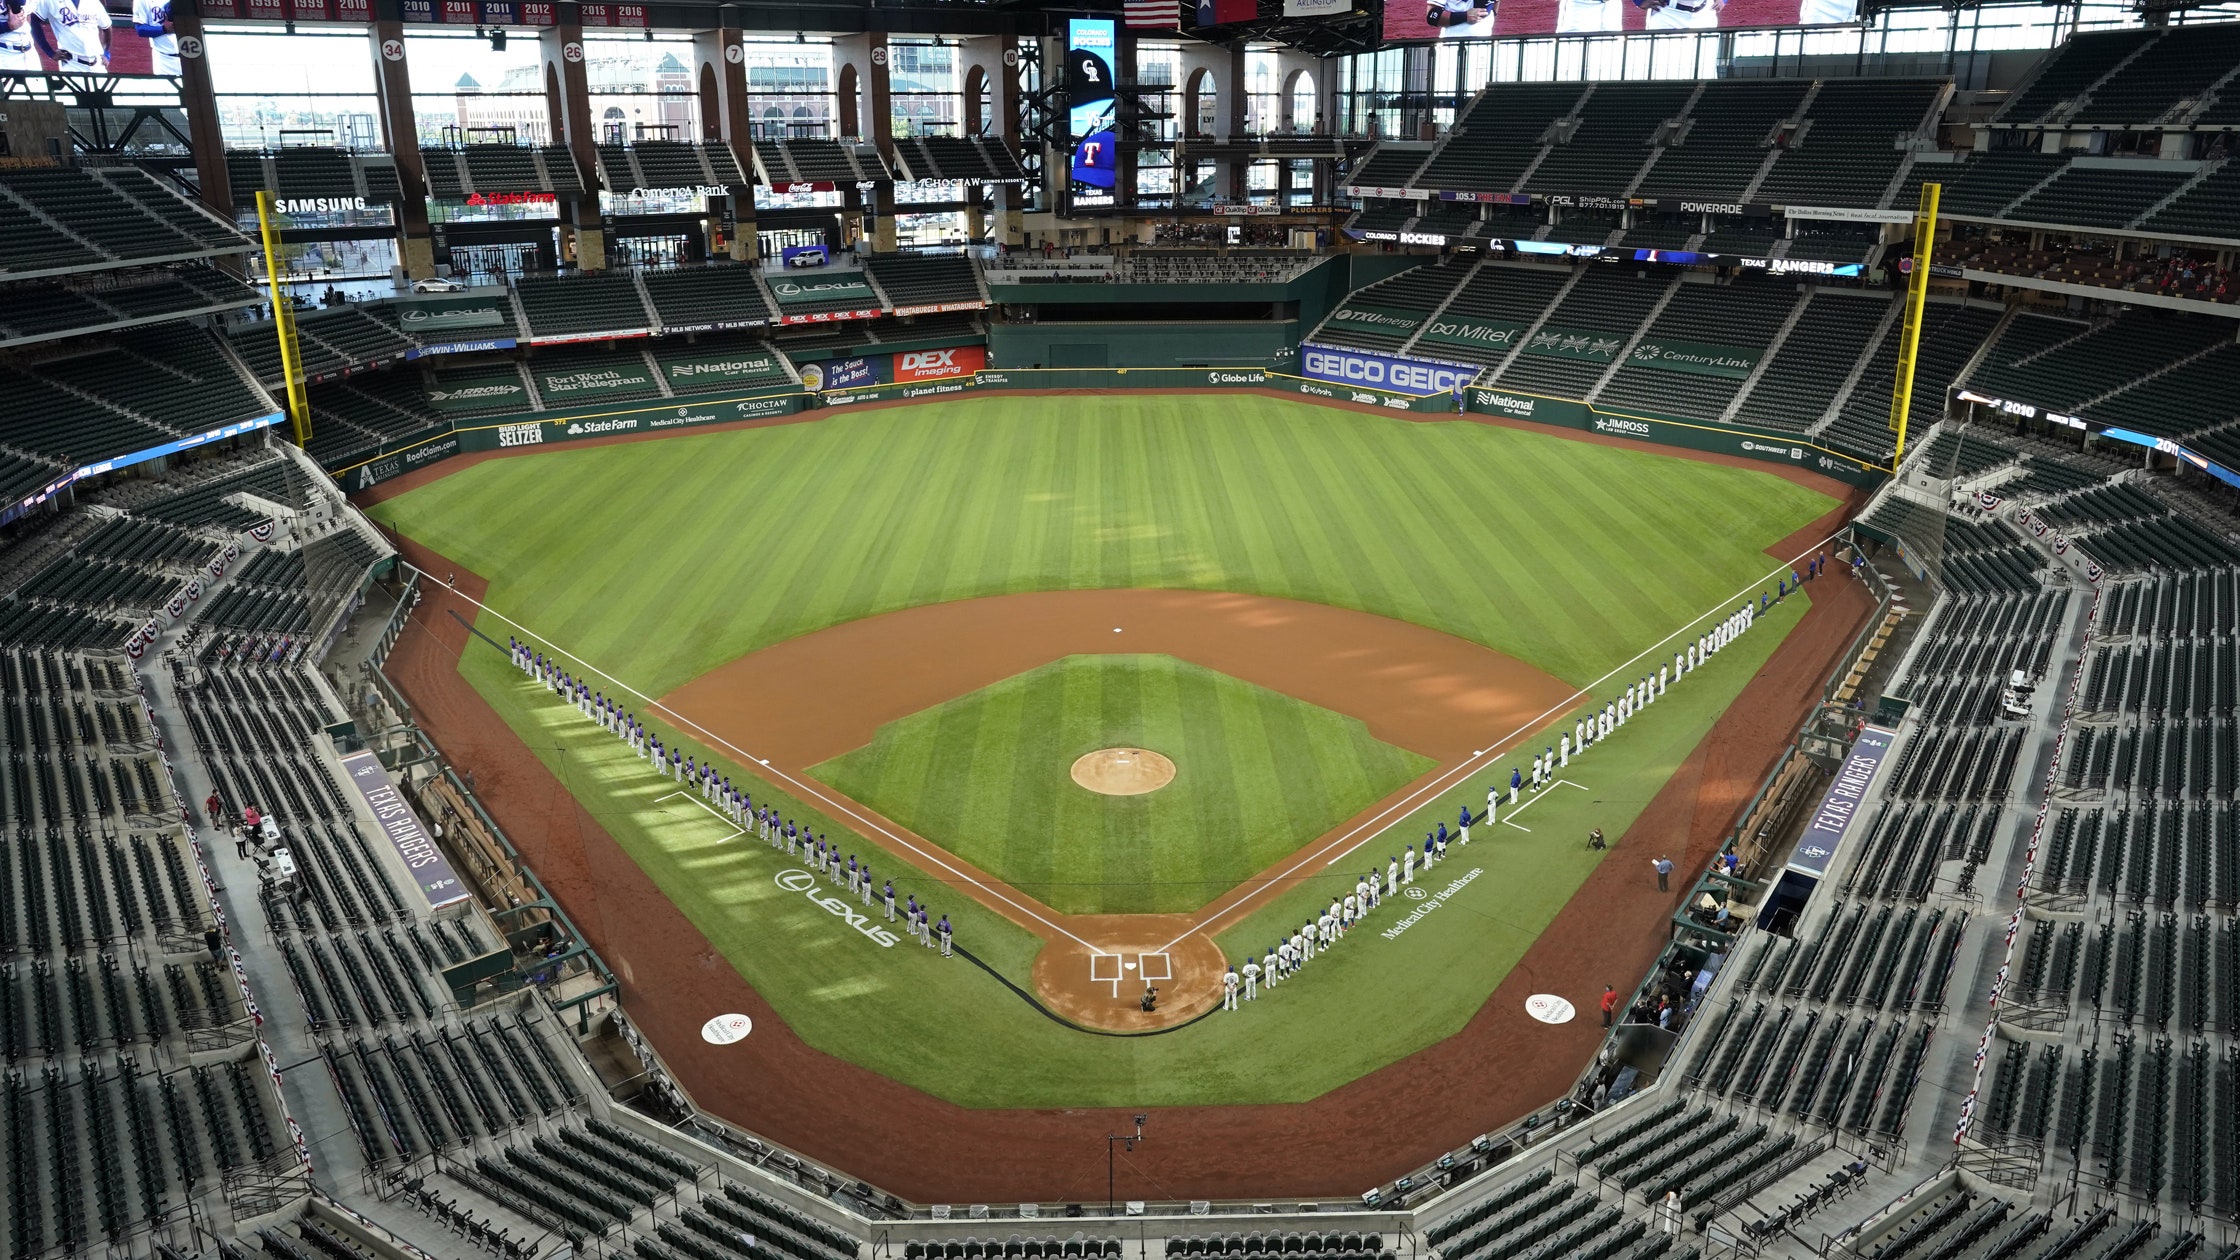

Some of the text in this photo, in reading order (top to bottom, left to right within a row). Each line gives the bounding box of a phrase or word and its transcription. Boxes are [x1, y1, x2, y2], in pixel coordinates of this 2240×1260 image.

[340, 0, 367, 9] 2010
[404, 1, 430, 12] 2010
[447, 2, 470, 12] 2011
[486, 3, 510, 13] 2011
[525, 4, 550, 14] 2012
[582, 5, 605, 15] 2015
[619, 6, 642, 16] 2016
[181, 41, 199, 53] 42
[1073, 36, 1112, 47] ROCKIES
[385, 45, 402, 56] 34
[566, 45, 581, 58] 26
[730, 47, 739, 61] 7
[874, 51, 886, 61] 29
[1006, 53, 1016, 63] 10
[925, 177, 981, 187] CHOCTAW
[696, 184, 730, 197] Bank
[1085, 188, 1103, 196] TEXAS
[1073, 195, 1115, 206] RANGERS
[1455, 192, 1476, 201] 105.3
[1552, 195, 1575, 205] PGL
[275, 196, 366, 214] SAMSUNG
[1225, 206, 1247, 214] QuikTrip
[1258, 206, 1280, 214] QuikTrip
[1680, 202, 1744, 214] POWERADE
[1365, 231, 1446, 246] COLORADO ROCKIES
[1740, 258, 1835, 274] TEXAS RANGERS
[802, 281, 866, 291] LEXUS
[430, 307, 497, 318] LEXUS
[895, 301, 983, 316] WHATABURGER WHATABURGER
[789, 314, 806, 322] DEX
[834, 311, 851, 319] DEX
[856, 309, 872, 317] DEX
[684, 324, 712, 332] NETWORK
[1455, 324, 1515, 343] Mitel
[901, 349, 957, 371] DEX
[1663, 349, 1750, 370] CenturyLink
[742, 366, 770, 374] Rental
[832, 365, 843, 375] The
[844, 358, 864, 370] Sauce
[914, 366, 961, 377] imaging
[1305, 352, 1384, 383] GEICO
[546, 371, 620, 385] Fort Worth
[832, 365, 869, 386] is the Boss!
[1221, 373, 1265, 383] Globe Life
[910, 384, 962, 397] planet fitness
[1309, 386, 1333, 397] Kubota
[742, 399, 788, 410] CHOCTAW
[2004, 400, 2035, 418] 2010
[1514, 409, 1531, 417] Rental
[650, 414, 716, 427] Medical City Healthcare
[517, 422, 541, 431] LIGHT
[499, 429, 543, 447] SELTZER
[406, 440, 457, 463] RoofClaim.com
[1755, 444, 1787, 455] SOUTHWEST
[2154, 437, 2179, 456] 2011
[373, 460, 399, 476] TEXAS
[1814, 797, 1854, 834] TEXAS
[1834, 755, 1877, 799] RANGERS
[366, 784, 404, 819] TEXAS
[386, 817, 438, 869] RANGERS
[1381, 867, 1484, 940] Medical City Healthcare
[805, 887, 901, 948] LEXUS
